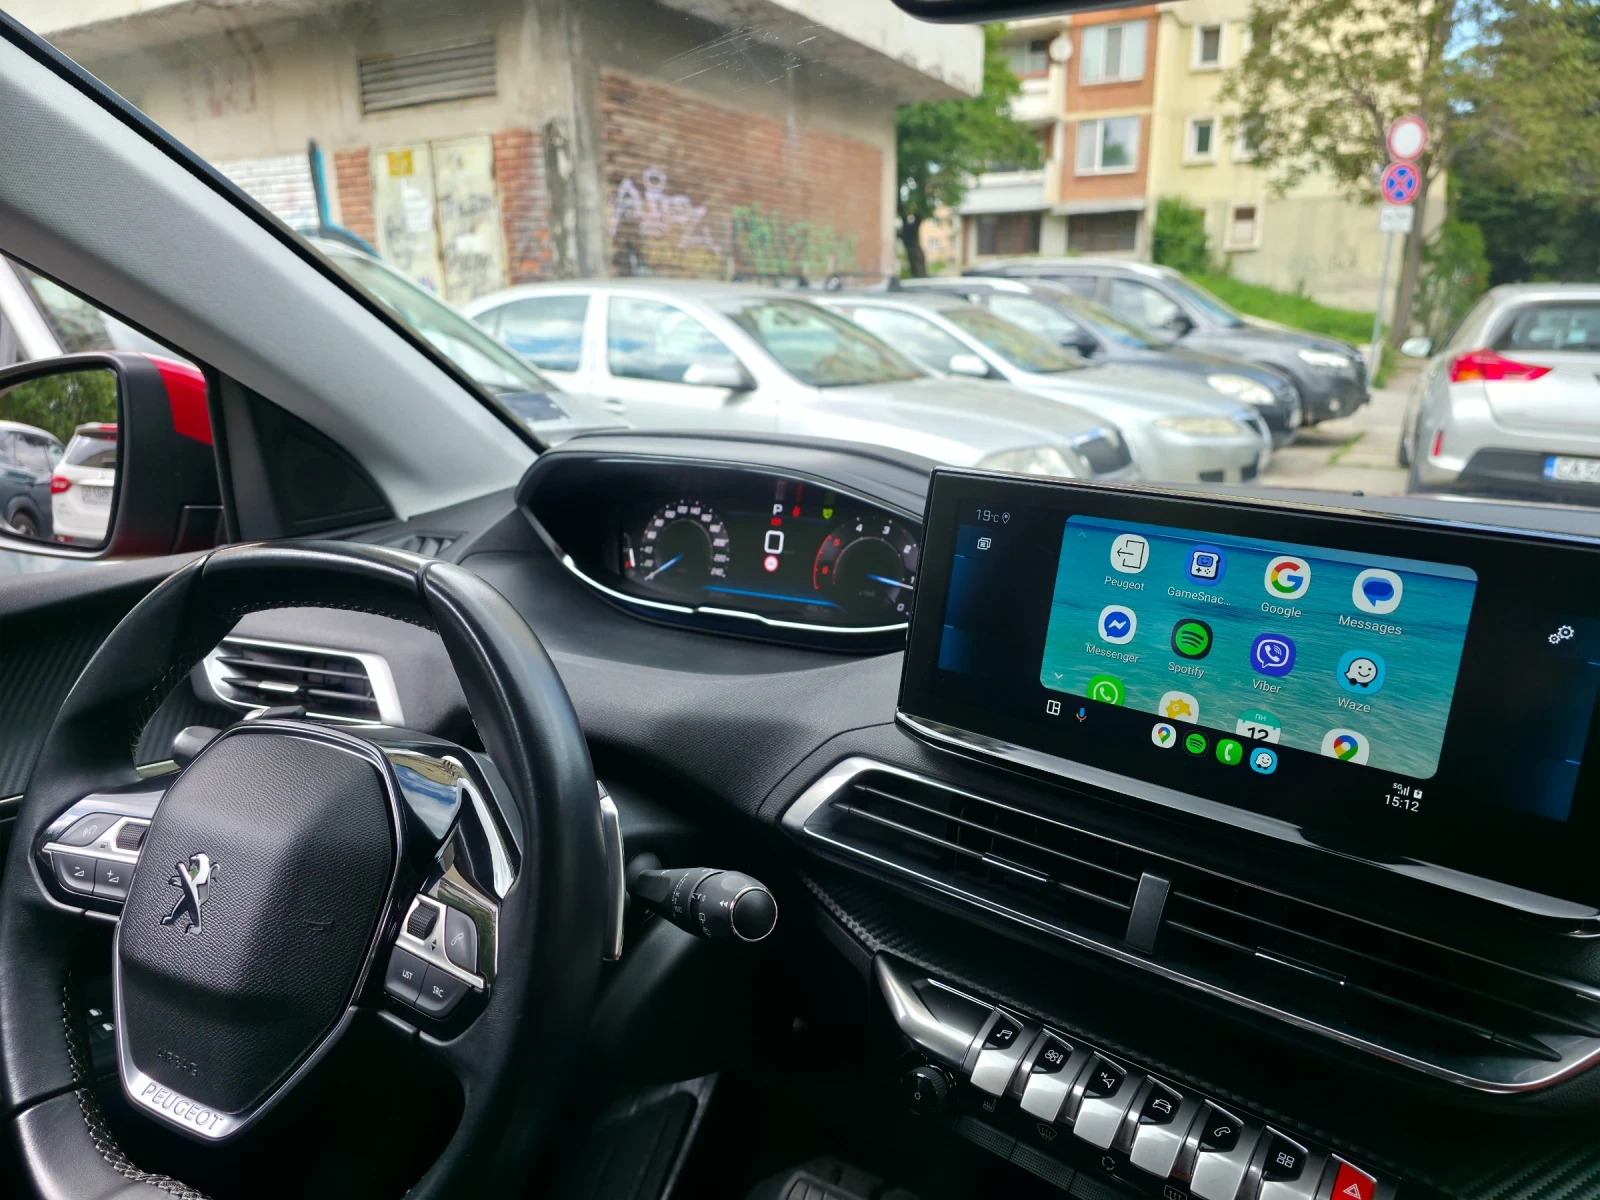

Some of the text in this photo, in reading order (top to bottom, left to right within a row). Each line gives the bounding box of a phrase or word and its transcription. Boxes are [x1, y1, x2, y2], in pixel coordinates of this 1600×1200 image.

[772, 504, 783, 515] P
[856, 523, 863, 533] 4
[882, 525, 890, 535] 3
[764, 530, 784, 554] 0
[1104, 575, 1145, 591] Peugeot
[1167, 586, 1231, 606] GameSnac...
[1261, 602, 1302, 618] Google
[1338, 615, 1402, 635] Messages
[1086, 643, 1139, 663] Messenger
[1168, 662, 1205, 679] Spotify
[1252, 679, 1281, 694] Viber
[1337, 697, 1371, 713] Waze
[1385, 794, 1420, 812] 15:12
[402, 969, 413, 980] LIST
[432, 985, 444, 998] SRC
[141, 1082, 224, 1130] PEUGEOT
